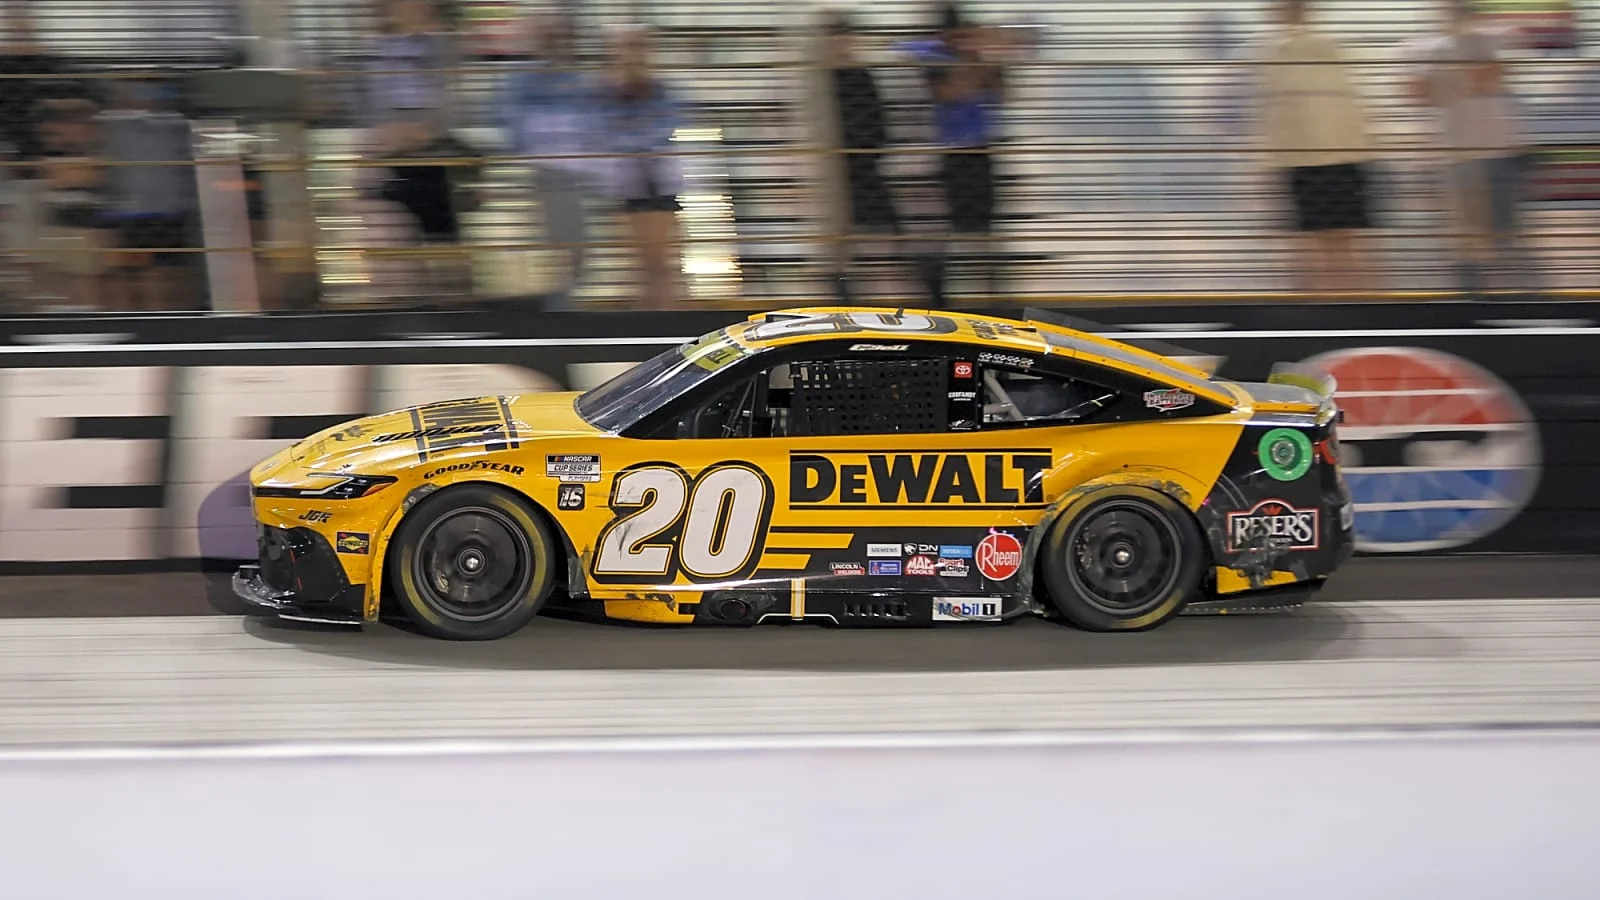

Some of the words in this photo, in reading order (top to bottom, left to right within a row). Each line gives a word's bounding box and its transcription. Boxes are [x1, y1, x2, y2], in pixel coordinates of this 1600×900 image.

[423, 459, 525, 480] GOODYEAR
[569, 464, 593, 472] SERIES
[789, 454, 1052, 504] DEWALT
[559, 487, 584, 507] 16
[594, 464, 770, 578] 20
[1234, 512, 1313, 545] RESER'S
[907, 557, 934, 569] MAC
[981, 534, 1020, 573] Rheem
[946, 565, 969, 573] Clips
[938, 602, 979, 616] Mobil
